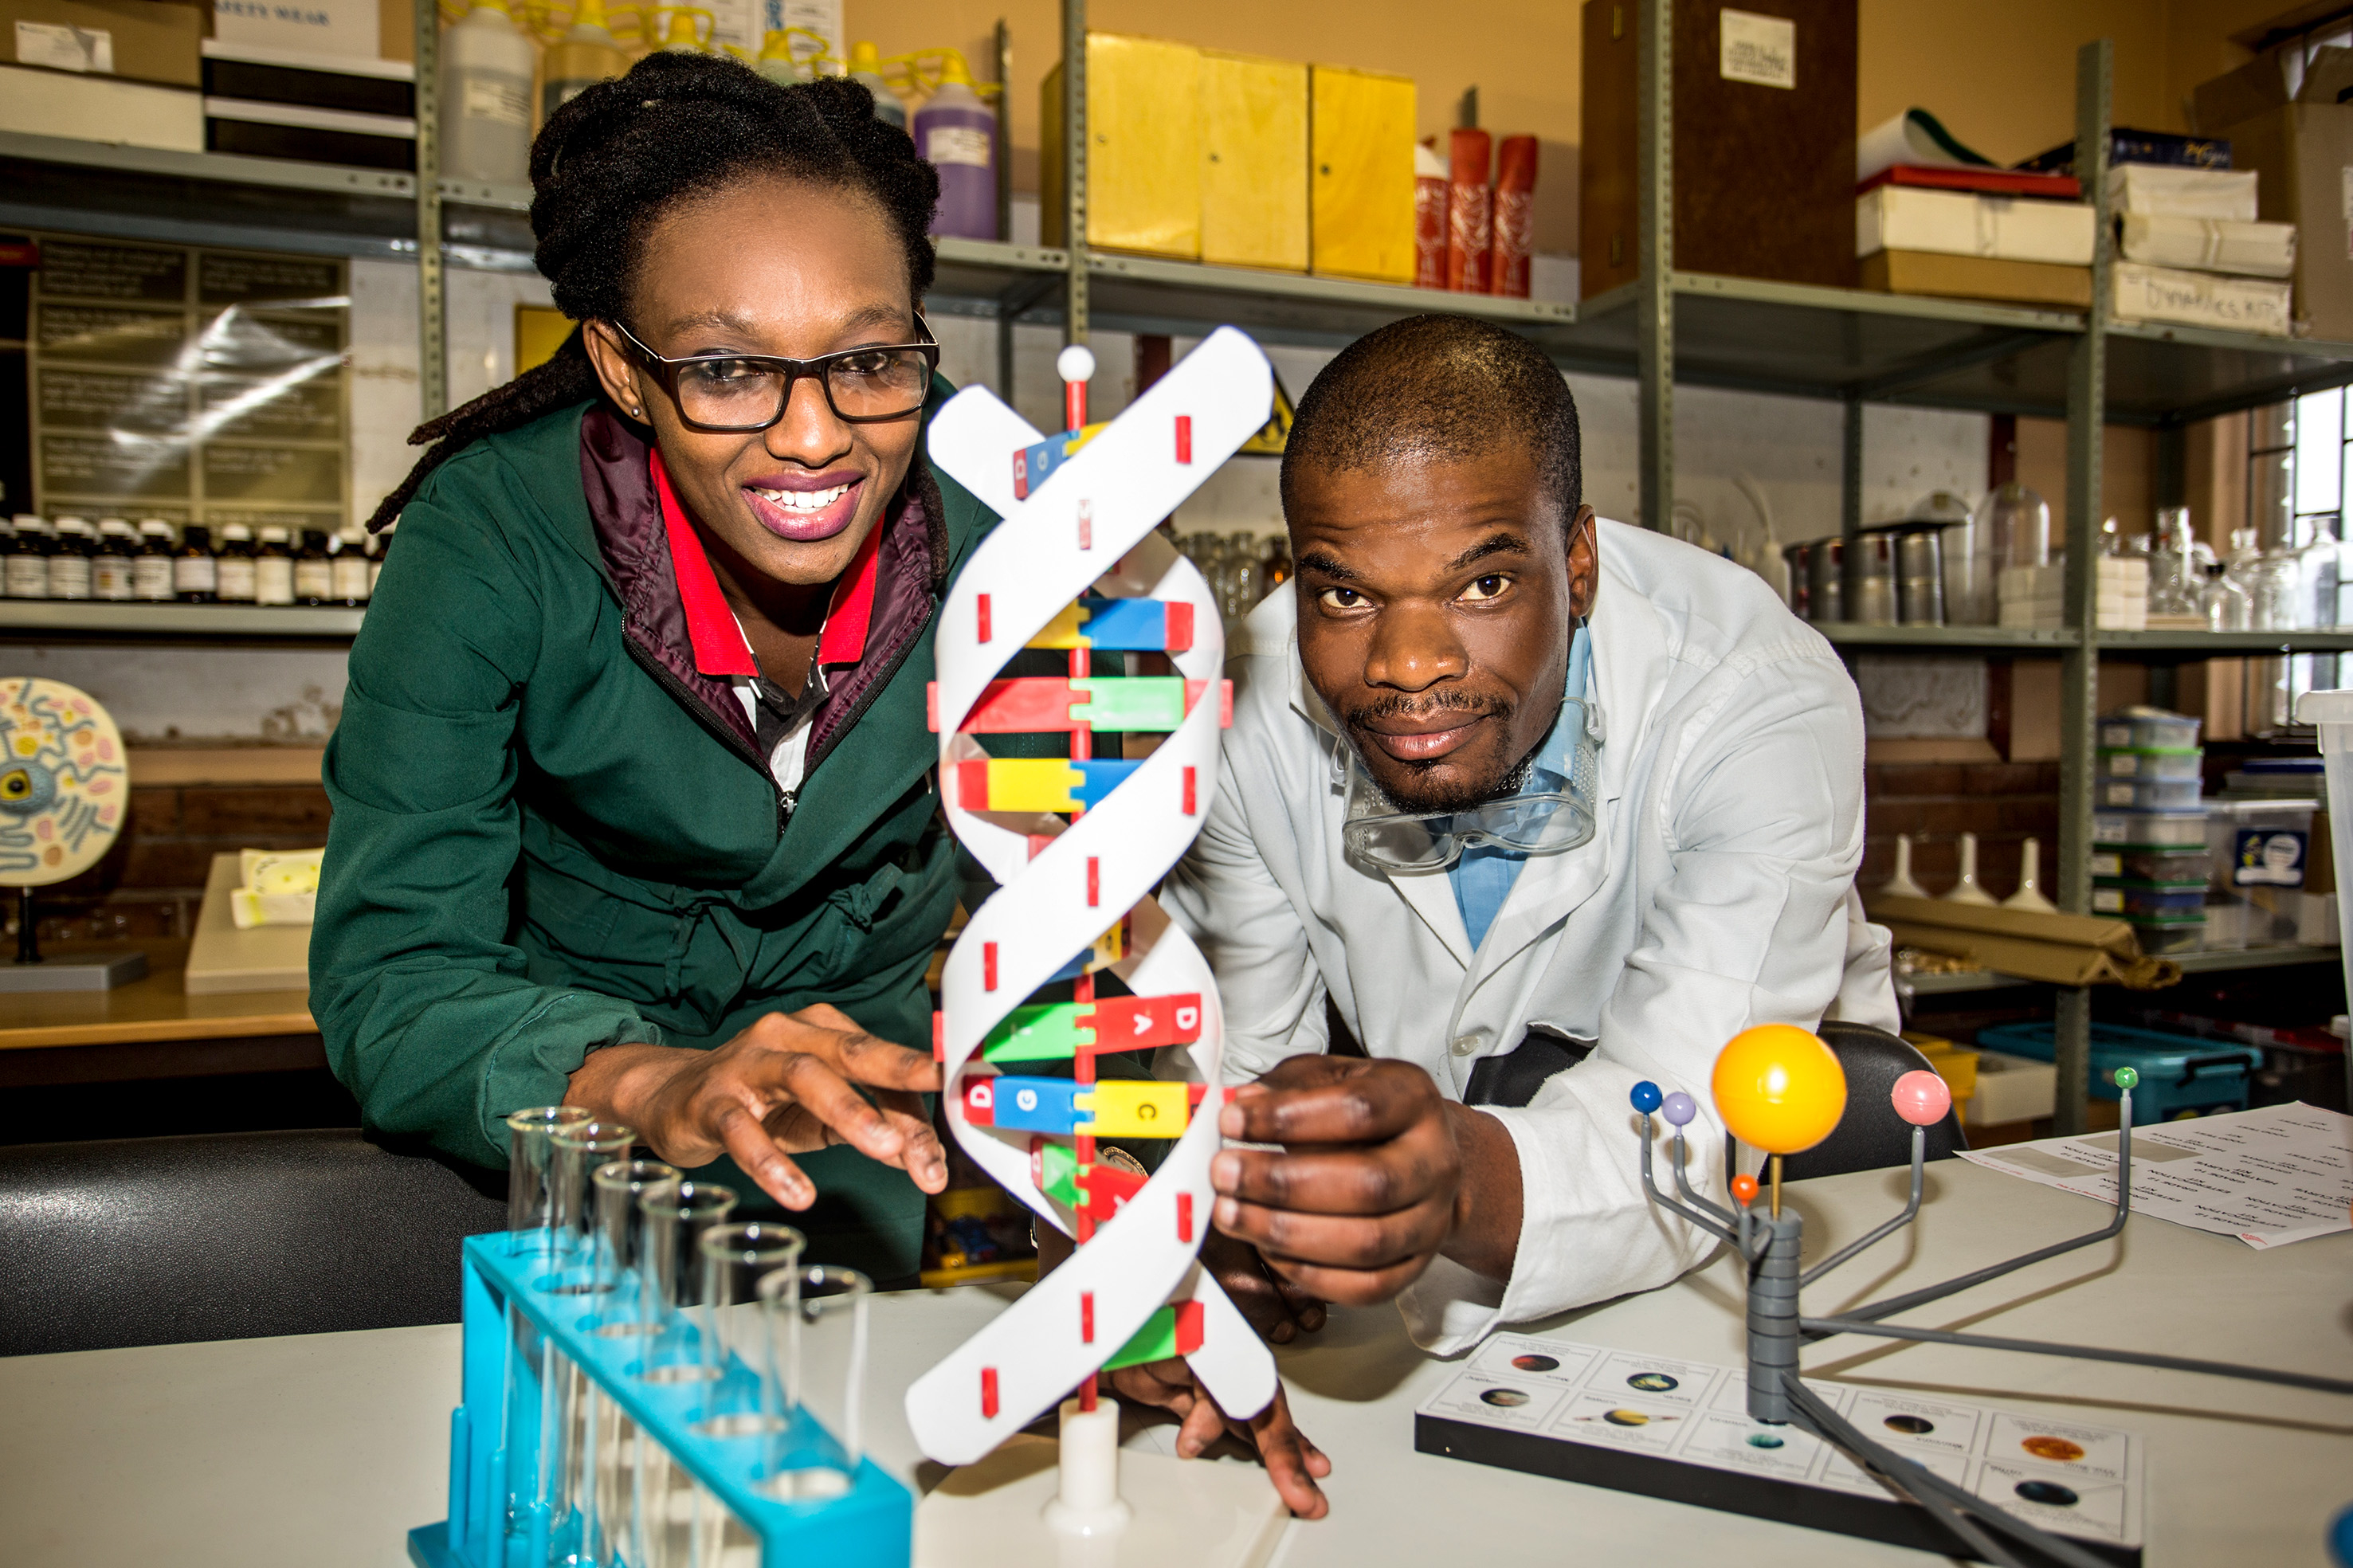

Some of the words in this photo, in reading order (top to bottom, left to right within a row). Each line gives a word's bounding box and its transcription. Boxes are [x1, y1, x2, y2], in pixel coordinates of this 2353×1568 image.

[1133, 1013, 1153, 1035] A
[1176, 1006, 1198, 1030] D
[970, 1084, 992, 1108] D
[1016, 1089, 1037, 1111] G
[1138, 1103, 1156, 1120] C
[2149, 1132, 2182, 1143] CURVE
[2162, 1141, 2196, 1151] GRADE
[2061, 1145, 2136, 1168] EERIFICATION
[2072, 1156, 2106, 1167] GRADE
[2238, 1154, 2276, 1166] CURVE
[2194, 1161, 2229, 1173] CURVE
[2253, 1164, 2292, 1174] GRADE
[2147, 1170, 2231, 1194] ESTERIFICATION
[2207, 1173, 2245, 1185] GRADE
[2230, 1171, 2278, 1186] HEATING
[2100, 1178, 2182, 1203] ESTERIFICION
[2161, 1181, 2198, 1193] GRADE
[2112, 1189, 2148, 1201] GRAE
[2292, 1187, 2333, 1200] CURVE
[2244, 1197, 2339, 1220] ESTERIFICATION
[2260, 1208, 2303, 1220] GRADE
[2194, 1205, 2288, 1229] ESTERIFICATION
[2210, 1217, 2251, 1228] GRADE
